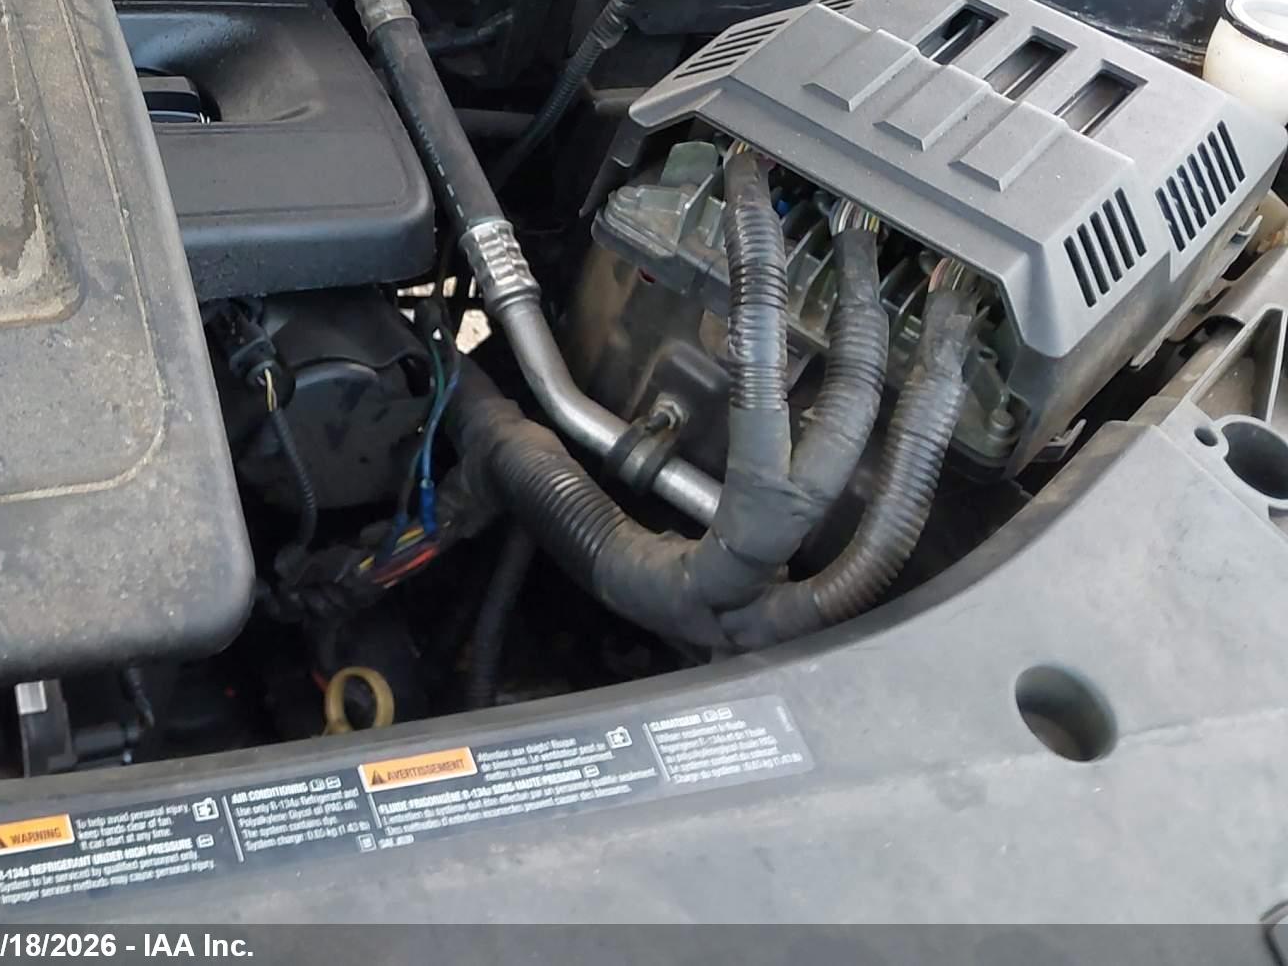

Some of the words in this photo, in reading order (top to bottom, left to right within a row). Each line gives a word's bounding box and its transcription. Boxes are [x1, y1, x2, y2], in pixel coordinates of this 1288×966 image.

[387, 759, 465, 780] AVERTISSEMENT
[231, 792, 247, 803] AIR
[248, 781, 308, 801] CONDITIONING
[10, 827, 61, 844] WARNING
[30, 855, 91, 875] REFRIGERANT
[92, 849, 123, 864] UNDER
[124, 846, 146, 859] HIGH
[147, 838, 192, 855] PRESSURE
